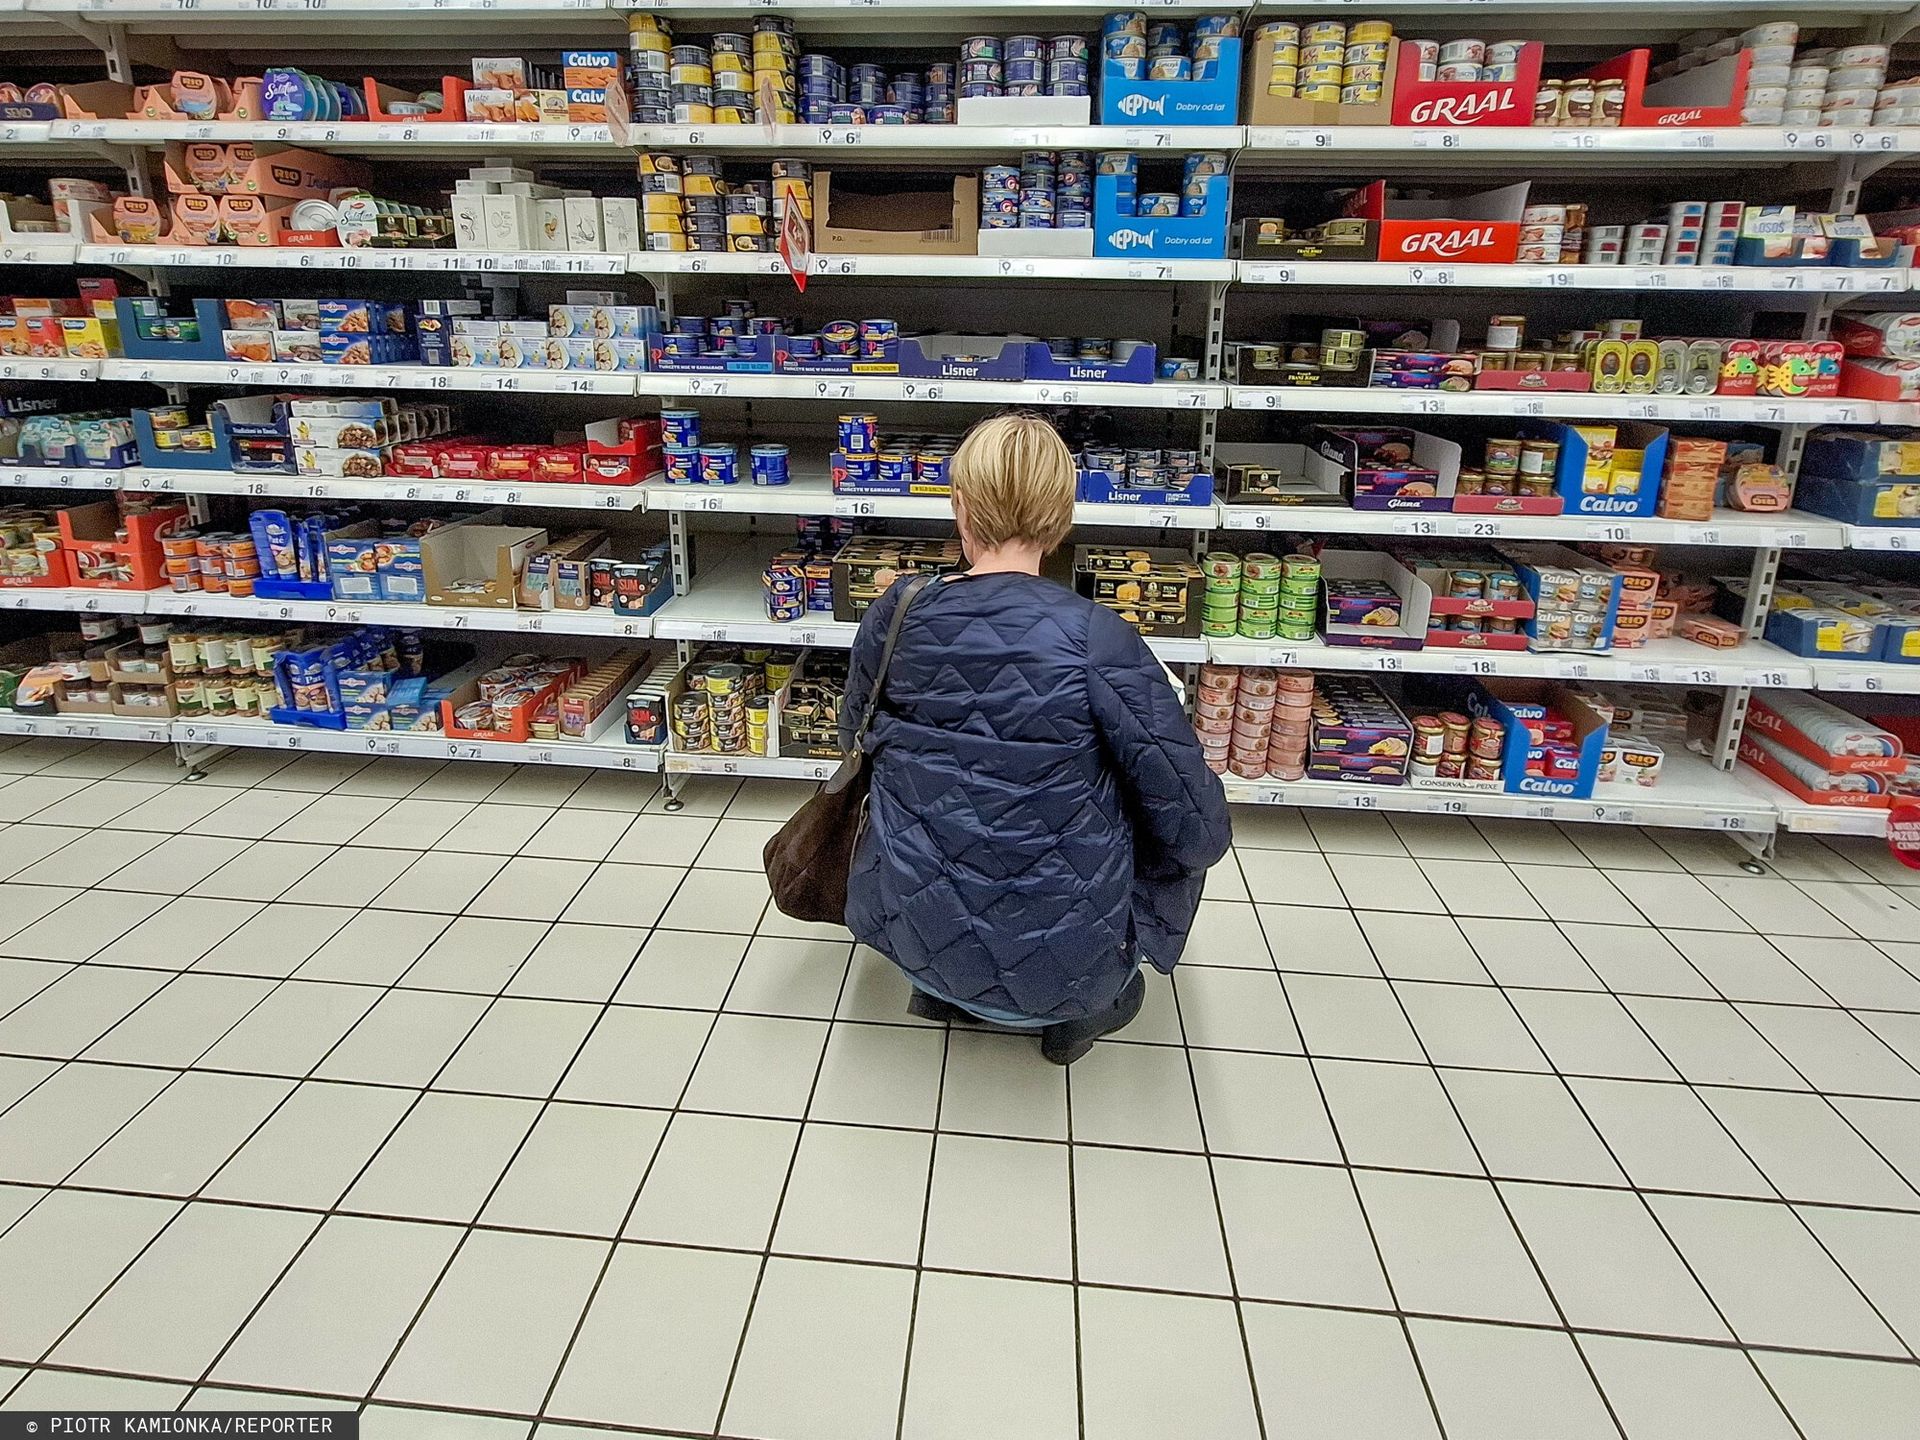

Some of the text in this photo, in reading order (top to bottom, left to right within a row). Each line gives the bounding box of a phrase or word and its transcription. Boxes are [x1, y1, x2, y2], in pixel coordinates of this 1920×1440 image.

[568, 53, 610, 67] Calvo
[572, 90, 604, 104] Calv
[1118, 94, 1166, 116] NEPTUN
[1176, 102, 1200, 112] Dobry
[1410, 88, 1515, 125] GRAAL
[1658, 110, 1702, 126] GRAAL
[277, 128, 286, 139] 9
[323, 130, 335, 142] 8
[403, 129, 413, 140] 8
[689, 132, 698, 144] 6
[846, 132, 855, 144] 6
[1155, 134, 1164, 146] 7
[1316, 135, 1325, 147] 9
[1443, 135, 1453, 147] 8
[1571, 135, 1594, 150] 16
[1815, 135, 1826, 148] 6
[1881, 136, 1892, 149] 6
[196, 148, 216, 158] RIO
[274, 168, 300, 180] RIO
[126, 202, 146, 210] RIO
[186, 199, 206, 208] RIO
[230, 200, 250, 209] RIO
[287, 235, 314, 244] GRAAL
[1108, 228, 1154, 250] NEPTUN
[1164, 236, 1188, 246] Dobry
[1402, 227, 1496, 257] GRAAL
[110, 252, 125, 263] 10
[170, 253, 186, 264] 10
[216, 254, 232, 265] 10
[300, 255, 309, 266] 6
[340, 256, 356, 267] 10
[391, 257, 406, 268] 11
[443, 258, 458, 269] 11
[476, 259, 492, 269] 10
[514, 259, 523, 270] 10
[542, 259, 551, 271] 10
[566, 260, 582, 271] 11
[608, 260, 617, 272] 7
[692, 260, 701, 271] 6
[770, 261, 779, 272] 6
[841, 262, 850, 273] 6
[1156, 267, 1166, 278] 7
[1280, 270, 1289, 282] 9
[1438, 272, 1448, 284] 8
[1547, 273, 1568, 286] 19
[1786, 276, 1796, 289] 7
[1836, 277, 1847, 290] 7
[1880, 277, 1891, 290] 7
[4, 367, 12, 377] 9
[41, 368, 49, 378] 9
[80, 369, 88, 379] 9
[942, 365, 978, 377] Lisner
[1069, 366, 1108, 379] Lisner
[388, 376, 396, 386] 7
[430, 377, 447, 388] 18
[496, 378, 513, 389] 14
[571, 381, 588, 392] 14
[714, 383, 722, 394] 7
[840, 386, 849, 397] 7
[928, 387, 937, 399] 6
[1063, 391, 1072, 403] 6
[1190, 395, 1200, 406] 7
[1266, 396, 1275, 408] 9
[1420, 400, 1439, 412] 13
[1527, 403, 1539, 414] 18
[1768, 408, 1778, 420] 7
[1839, 409, 1850, 421] 7
[14, 474, 22, 485] 9
[60, 476, 68, 486] 9
[104, 477, 113, 488] 9
[161, 480, 170, 490] 4
[248, 484, 263, 494] 18
[308, 486, 324, 496] 16
[406, 488, 415, 498] 8
[455, 490, 465, 500] 8
[507, 492, 516, 503] 8
[1108, 490, 1142, 502] Lisner
[606, 496, 615, 507] 8
[702, 499, 717, 509] 16
[1580, 496, 1638, 514] Calvo
[852, 503, 869, 514] 16
[1163, 516, 1171, 527] 7
[1256, 516, 1265, 528] 9
[1411, 522, 1431, 533] 13
[1474, 523, 1494, 535] 23
[1605, 528, 1624, 540] 10
[1890, 537, 1901, 549] 6
[2, 577, 33, 586] GRAAL
[1541, 572, 1574, 585] Calvo
[1623, 577, 1651, 588] RIO
[620, 580, 638, 590] SUM
[280, 608, 288, 618] 9
[455, 616, 463, 627] 7
[1616, 616, 1645, 626] RIO
[624, 624, 632, 635] 8
[712, 630, 722, 640] 18
[802, 633, 813, 644] 18
[1282, 653, 1291, 664] 7
[1378, 658, 1396, 669] 13
[1472, 662, 1490, 673] 18
[1692, 671, 1711, 683] 13
[1762, 673, 1782, 685] 18
[1866, 678, 1876, 690] 6
[25, 723, 34, 733] 7
[66, 726, 73, 735] 7
[87, 727, 96, 736] 7
[149, 731, 156, 739] 7
[289, 737, 296, 747] 9
[469, 748, 477, 758] 7
[623, 758, 631, 768] 8
[1626, 754, 1656, 766] RIO
[1850, 760, 1890, 770] GRAAL
[724, 763, 733, 773] 5
[815, 767, 822, 778] 6
[1520, 778, 1575, 795] Calvo
[1270, 792, 1279, 802] 7
[1354, 797, 1371, 807] 13
[1830, 794, 1870, 805] GRAAL
[1444, 802, 1461, 812] 19
[1722, 818, 1739, 829] 18
